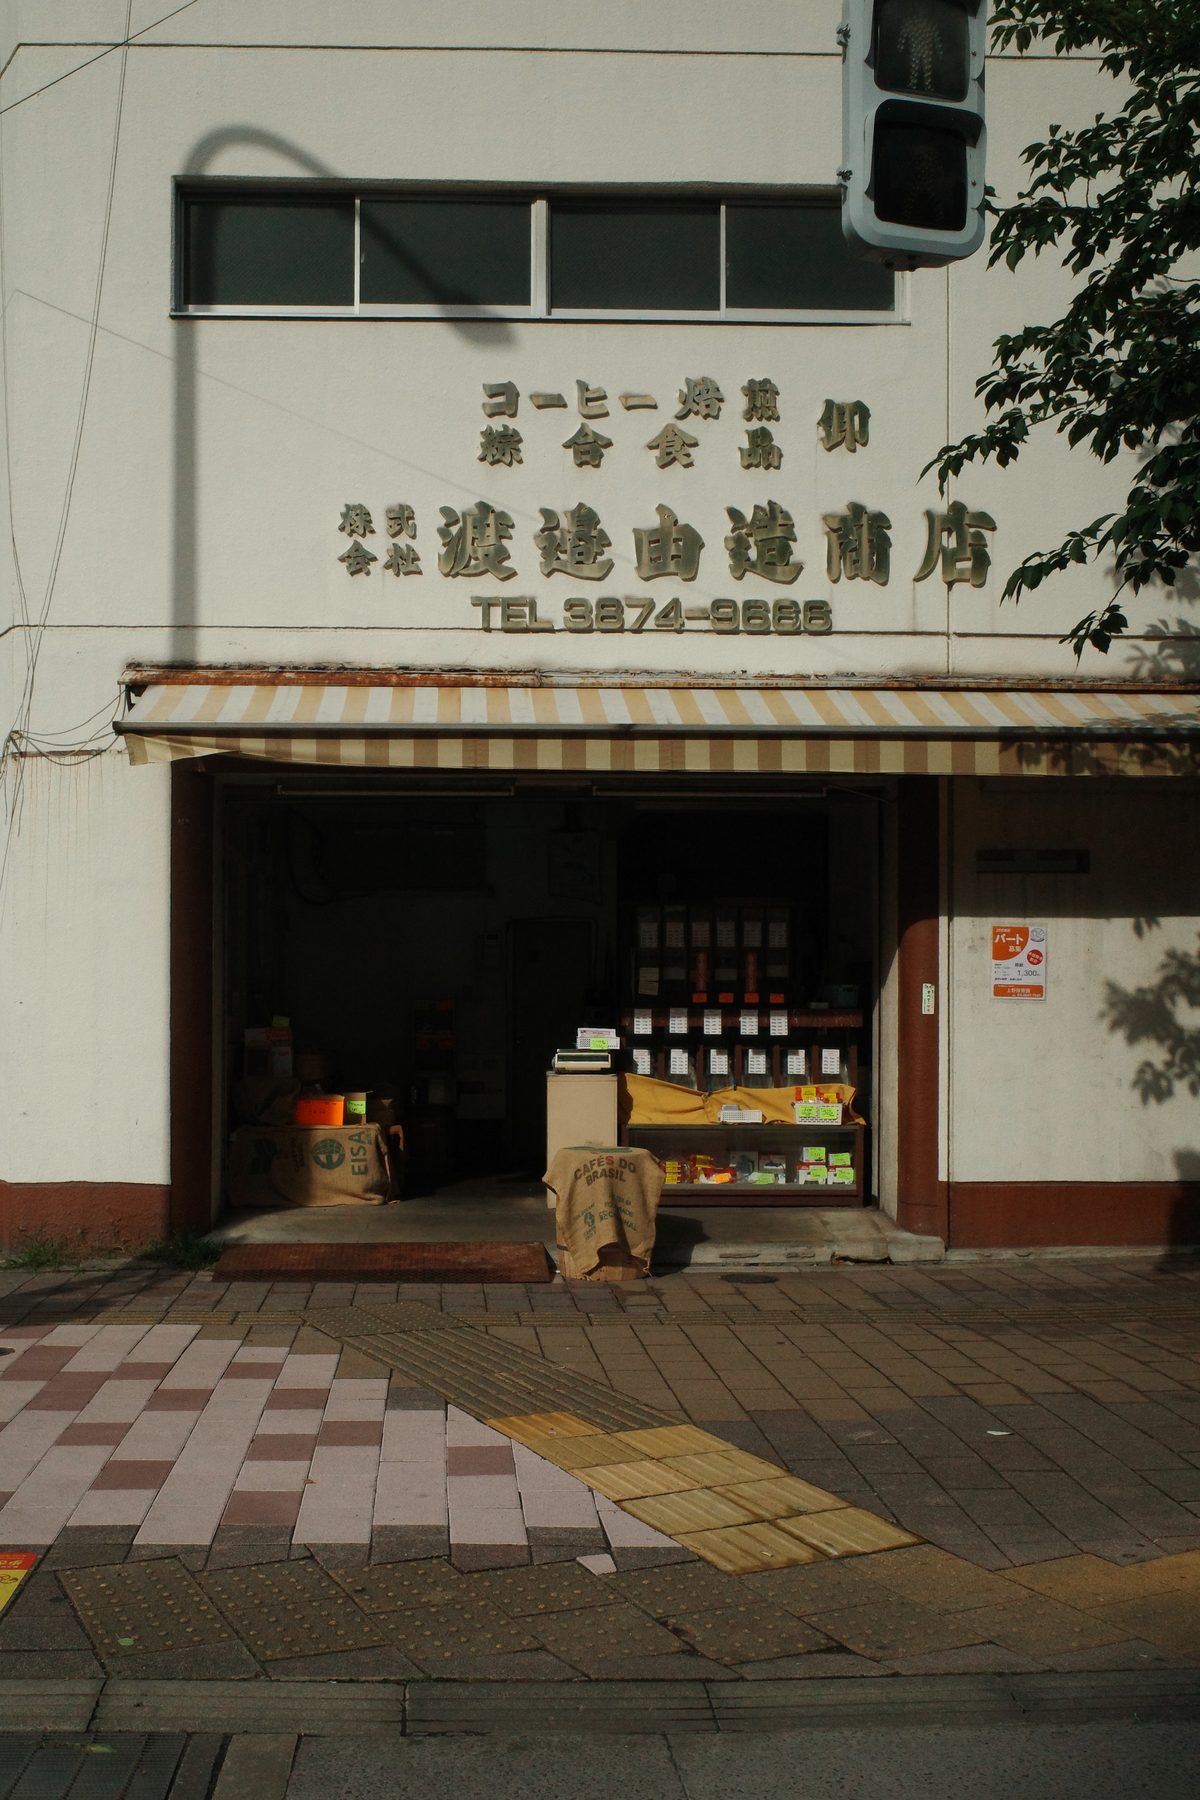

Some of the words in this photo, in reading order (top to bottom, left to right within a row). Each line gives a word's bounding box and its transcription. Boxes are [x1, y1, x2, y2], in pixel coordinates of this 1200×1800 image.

[481, 376, 779, 421] コーヒー焙煎
[817, 398, 871, 452] 卸
[477, 423, 782, 470] 綜合食品
[471, 597, 555, 632] TEL
[994, 934, 1023, 945] パート
[348, 1131, 368, 1176] EISA
[619, 1157, 636, 1174] DO
[585, 1168, 626, 1186] BRASIL
